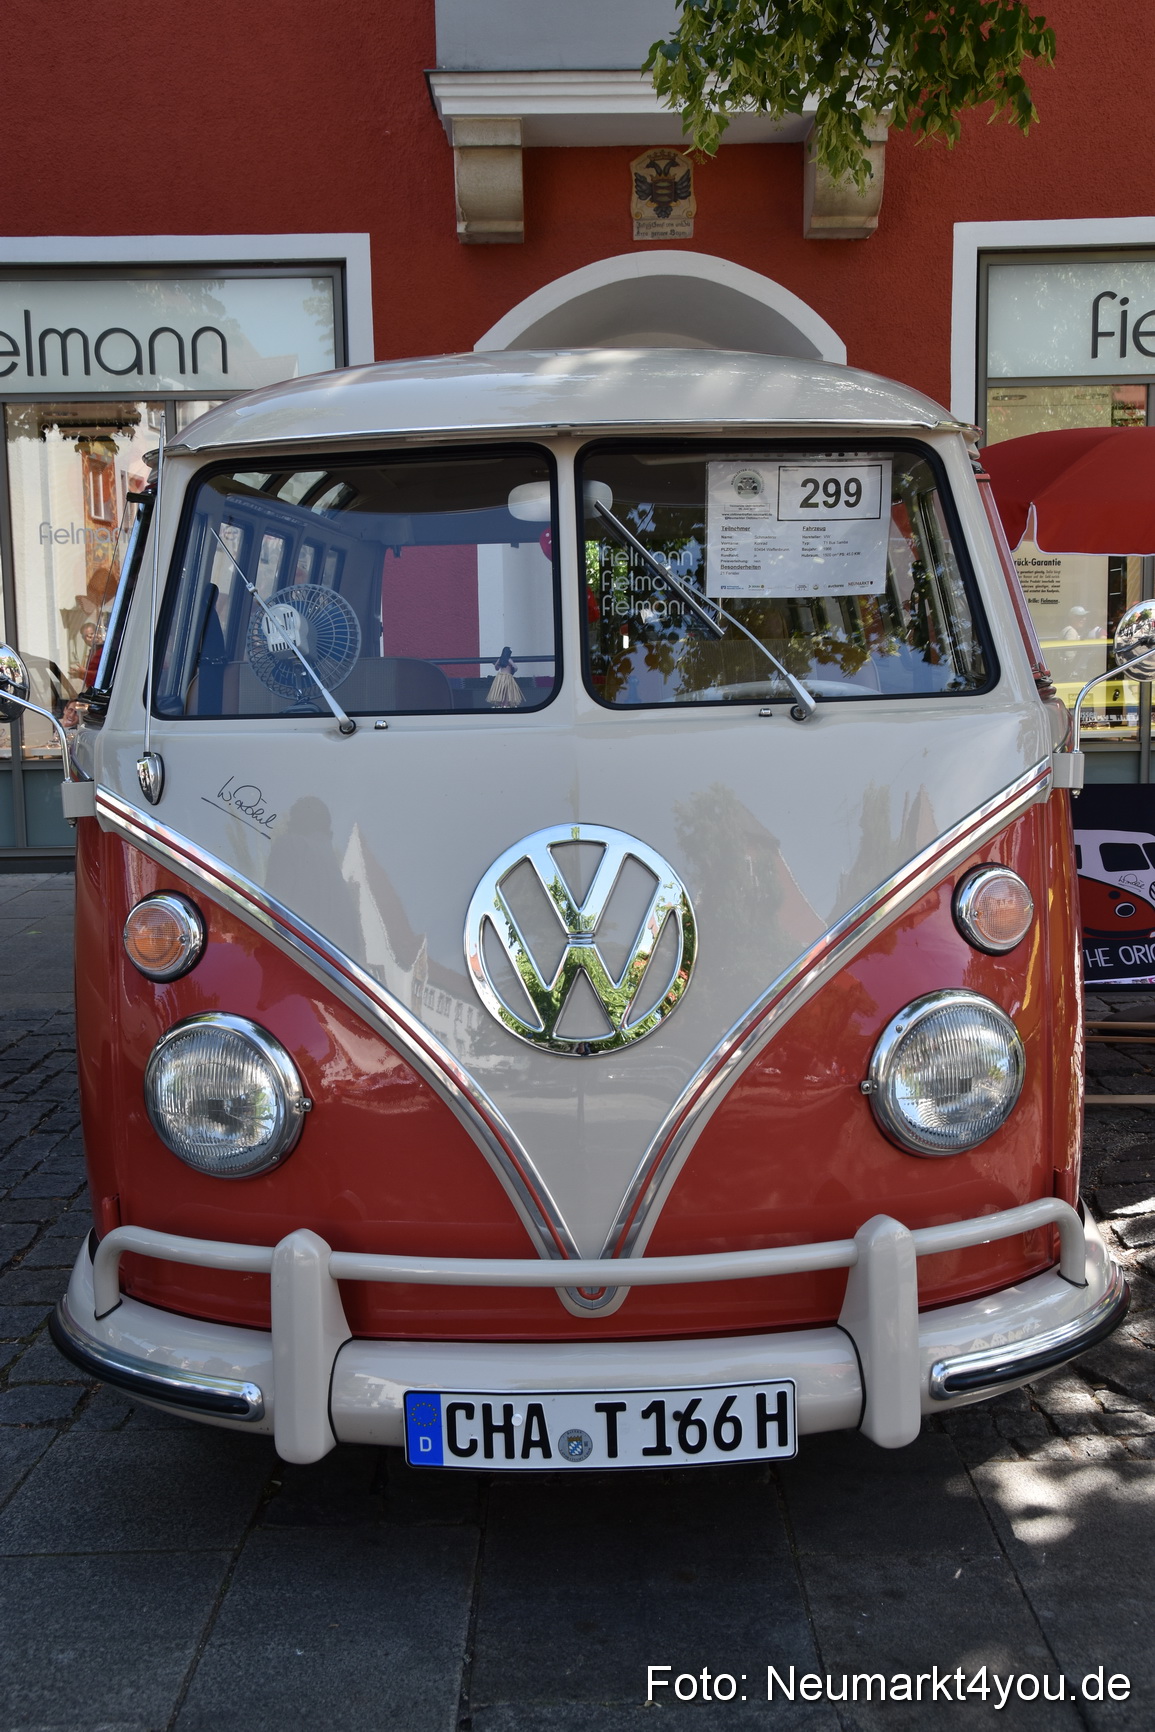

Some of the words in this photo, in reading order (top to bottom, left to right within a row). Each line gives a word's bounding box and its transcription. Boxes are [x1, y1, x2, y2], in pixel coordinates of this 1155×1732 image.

[799, 477, 862, 509] 299
[39, 522, 129, 545] fielman
[602, 570, 693, 592] fielman
[1082, 947, 1114, 968] HE
[446, 1401, 553, 1460] CHA
[419, 1436, 432, 1452] D
